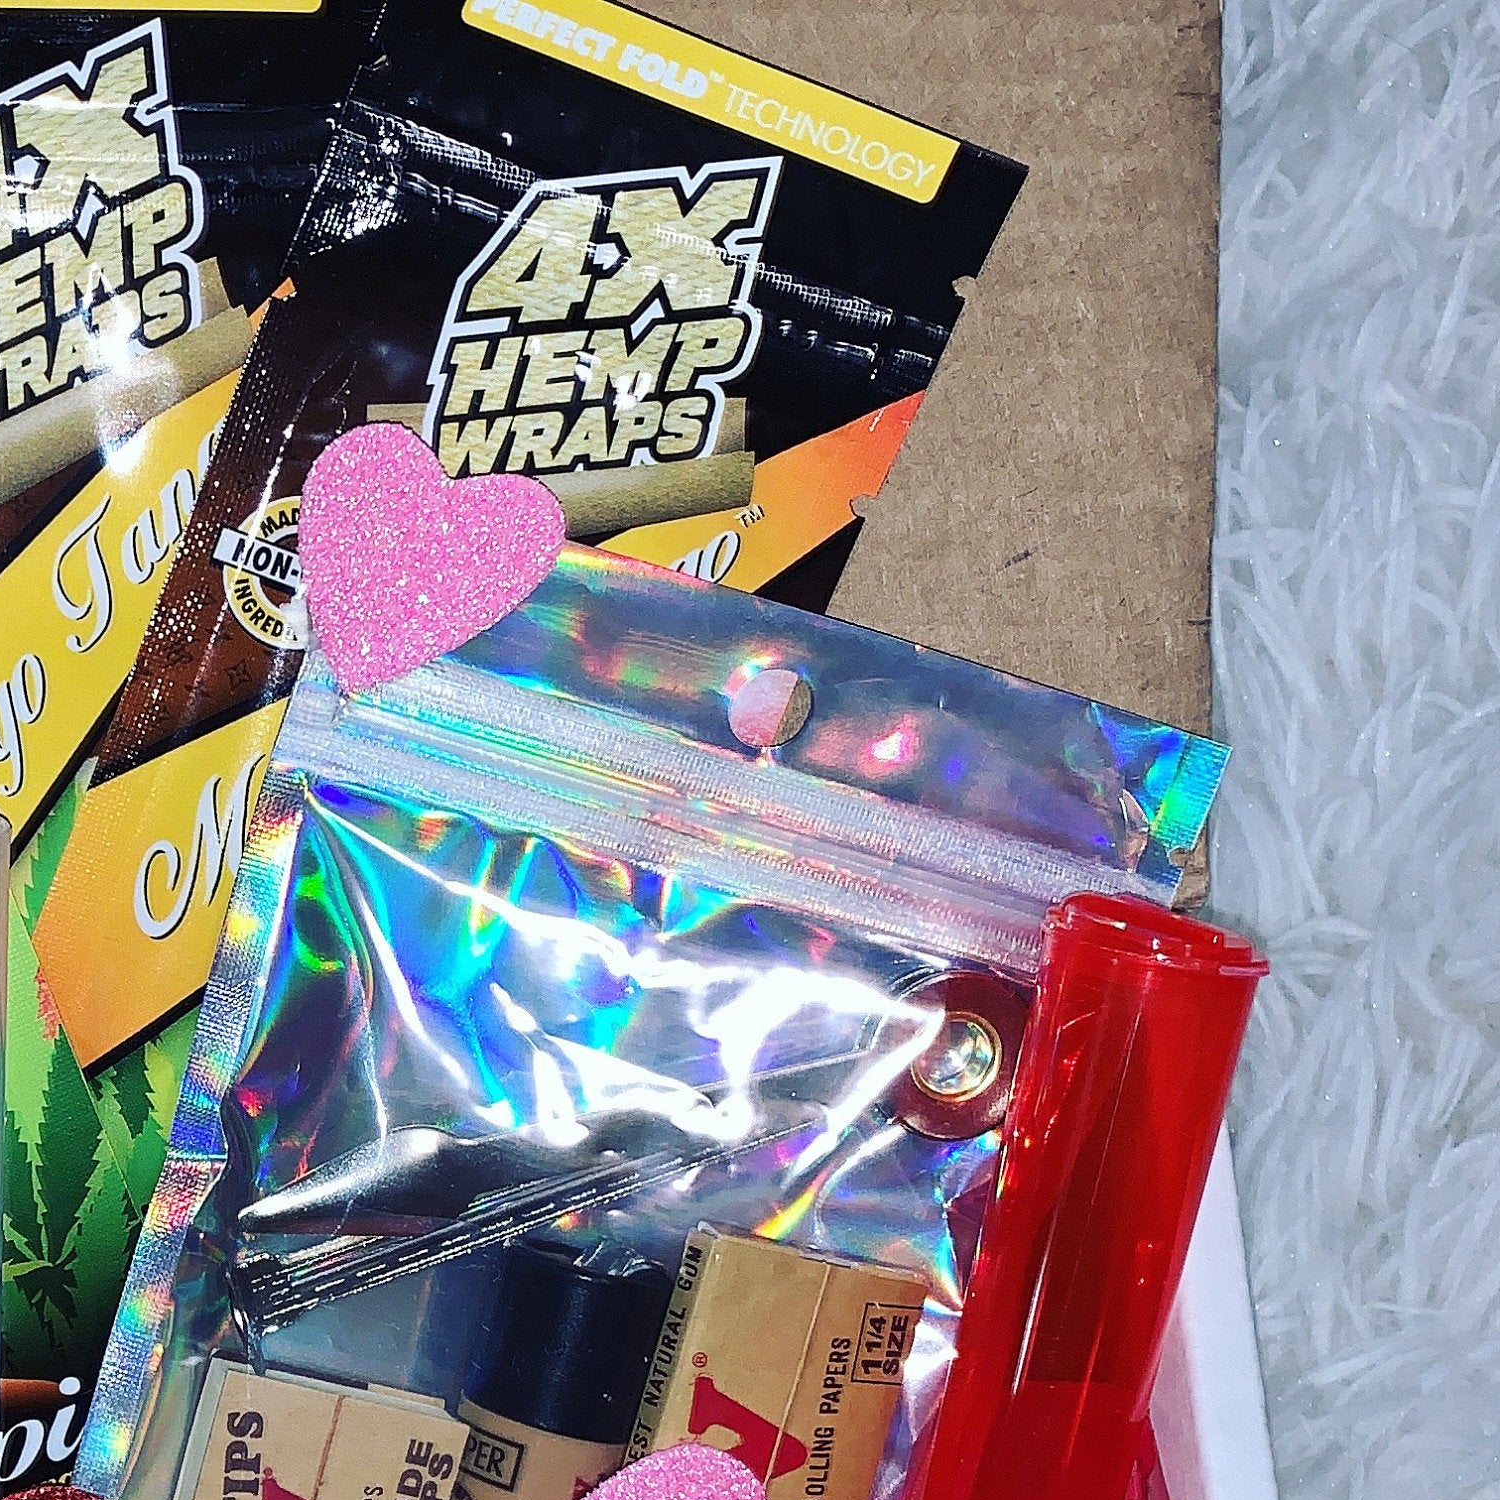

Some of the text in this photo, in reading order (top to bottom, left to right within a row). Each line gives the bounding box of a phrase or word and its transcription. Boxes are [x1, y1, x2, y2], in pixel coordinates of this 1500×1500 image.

[471, 0, 618, 62] PERFECT
[724, 83, 936, 188] TECHNOLOGY
[464, 176, 760, 325] 4X
[442, 315, 746, 418] HEMP
[437, 395, 710, 479] WRAPS
[233, 578, 297, 642] INGRED
[643, 1306, 687, 1408] NATURAL
[677, 1244, 703, 1292] GUM
[882, 1314, 909, 1377] SIZE
[819, 1336, 851, 1415] PAPERS
